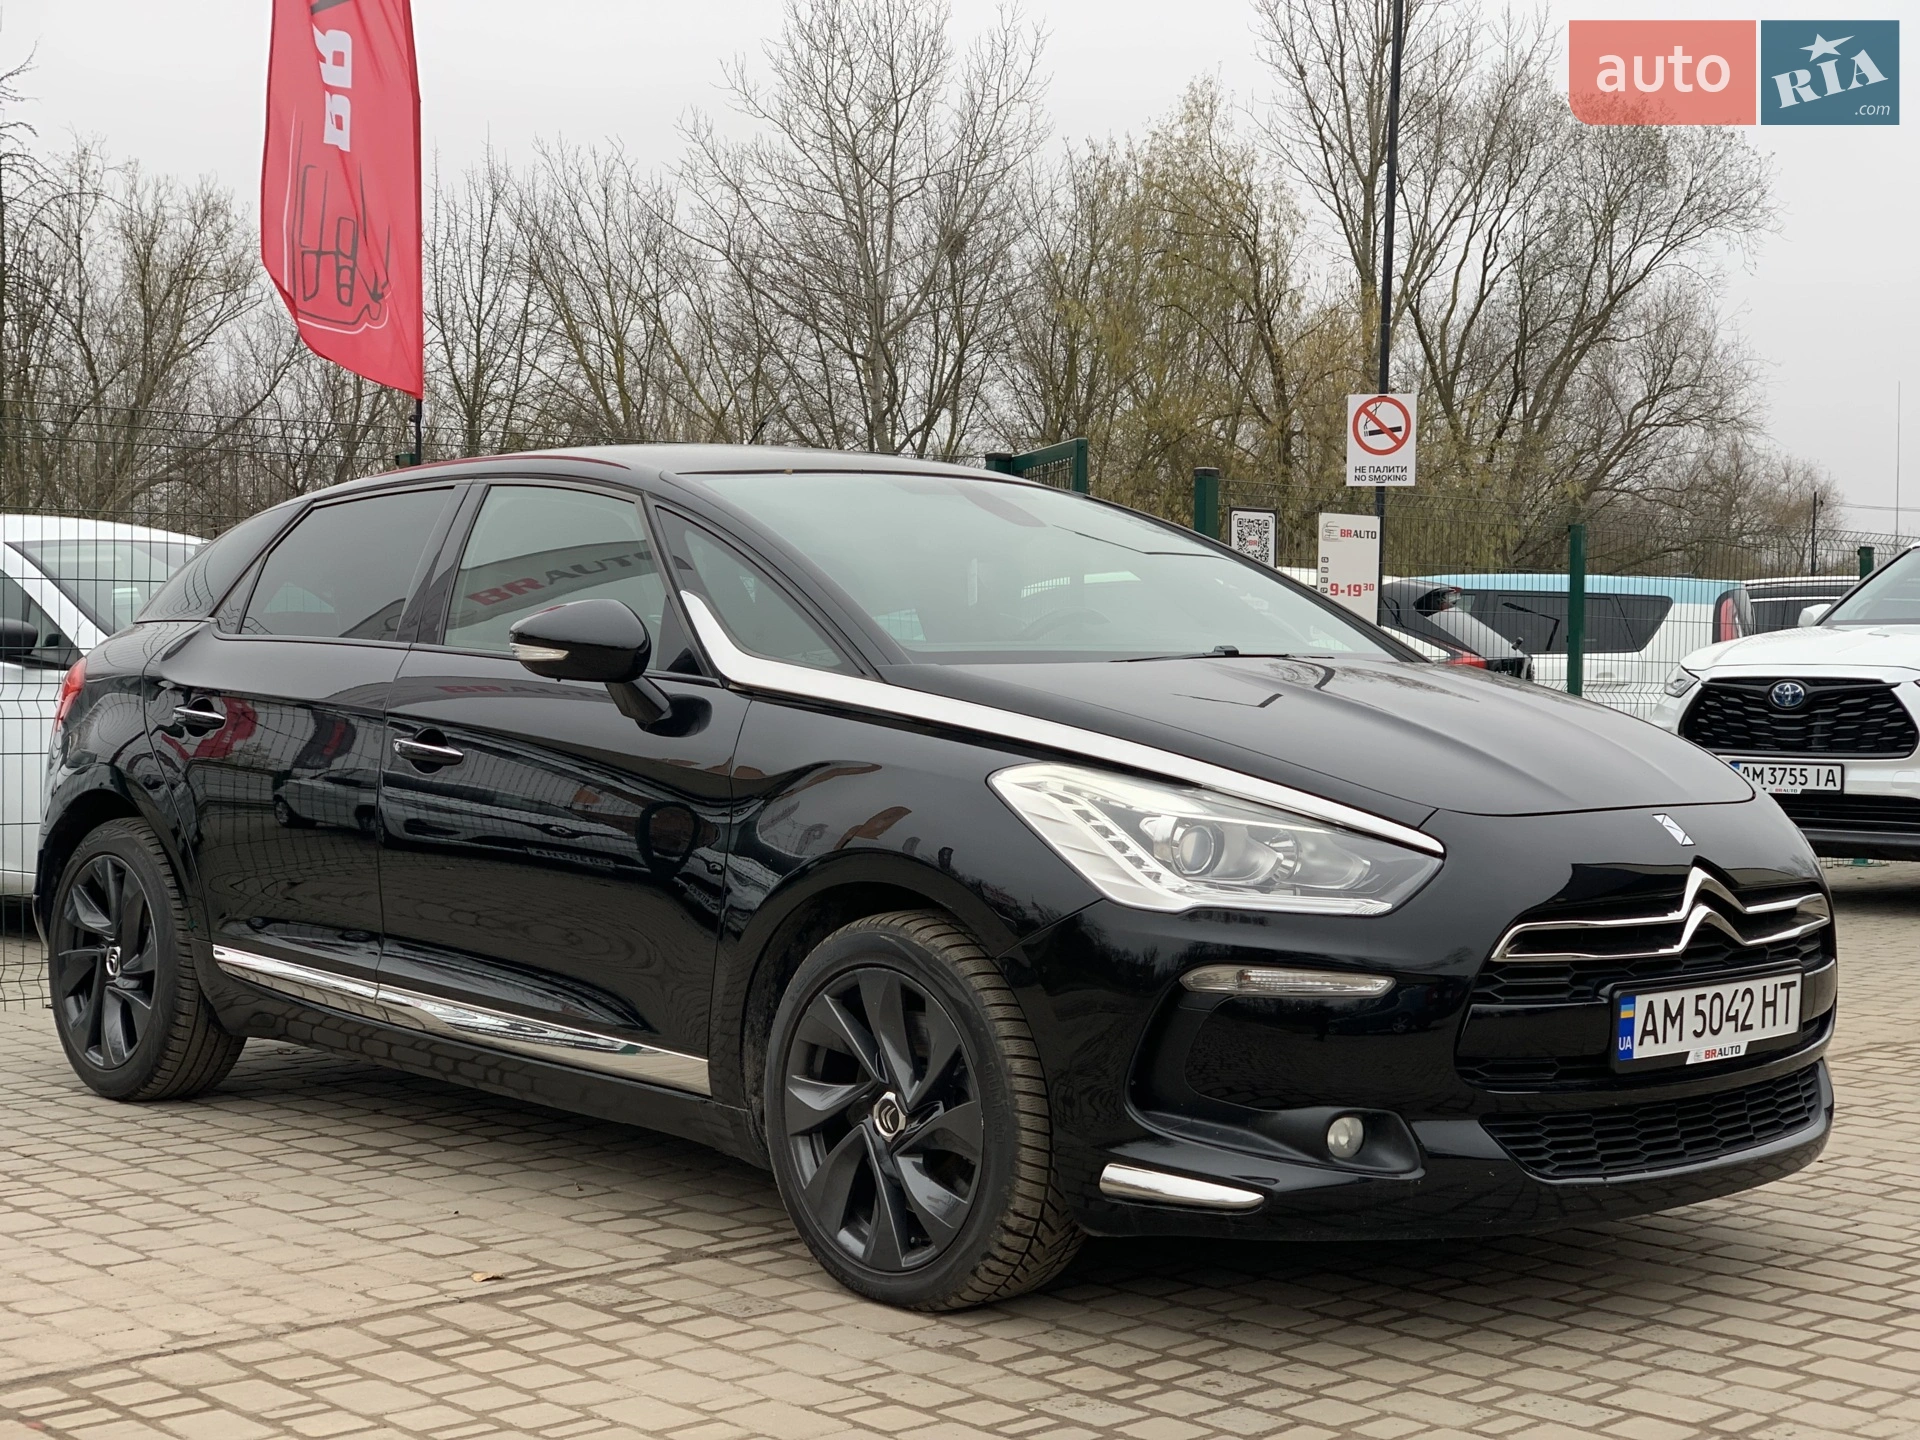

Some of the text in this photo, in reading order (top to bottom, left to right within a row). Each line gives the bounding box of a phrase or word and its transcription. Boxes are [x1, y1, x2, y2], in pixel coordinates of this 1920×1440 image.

[1340, 529, 1377, 539] BRAUTO
[1768, 767, 1808, 786] 3755
[1638, 981, 1797, 1047] AM 5042 HT
[1619, 1036, 1632, 1050] UA
[1704, 1045, 1741, 1060] BRAUTO
